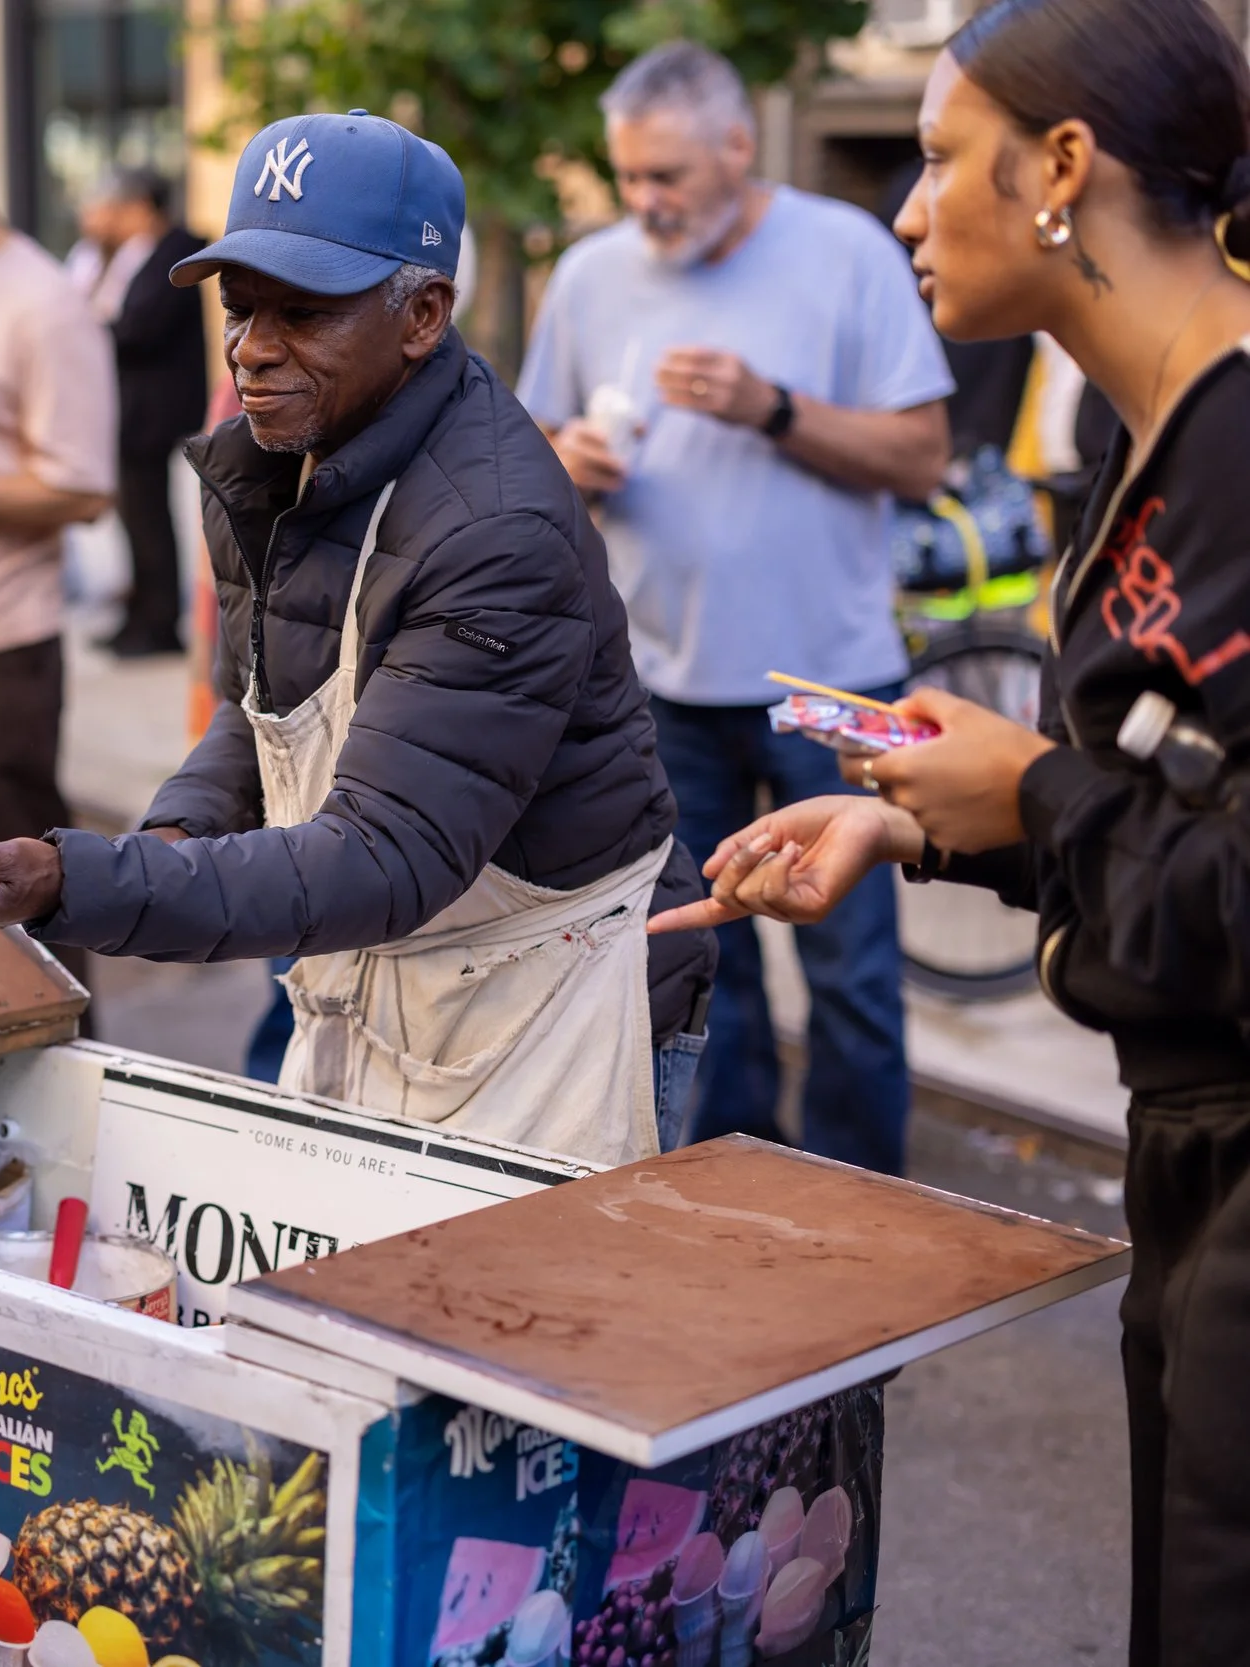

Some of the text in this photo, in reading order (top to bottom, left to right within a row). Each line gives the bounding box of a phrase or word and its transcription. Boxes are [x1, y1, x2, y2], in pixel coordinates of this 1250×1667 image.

[254, 137, 315, 202] NY
[457, 626, 506, 653] Calvin Klein
[299, 1142, 318, 1157] AS
[325, 1147, 353, 1166] YOU
[126, 1181, 363, 1284] MONT
[515, 1439, 580, 1502] ICES
